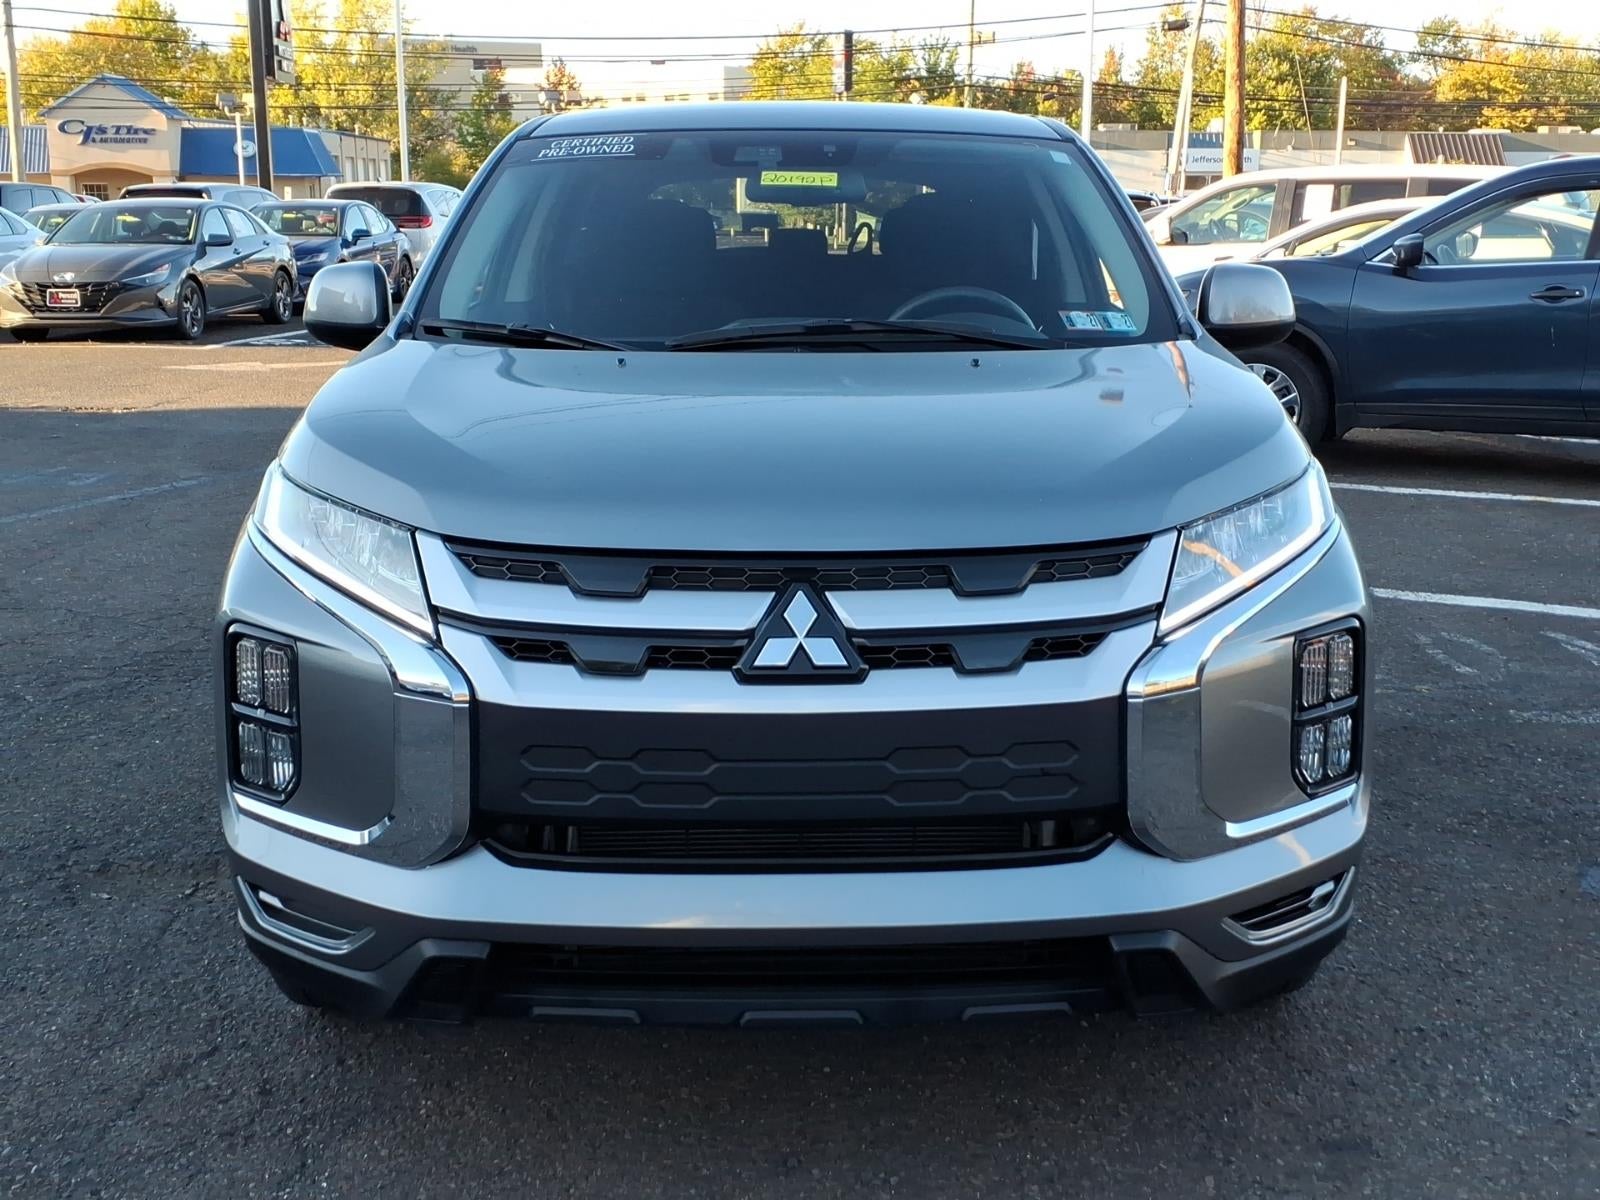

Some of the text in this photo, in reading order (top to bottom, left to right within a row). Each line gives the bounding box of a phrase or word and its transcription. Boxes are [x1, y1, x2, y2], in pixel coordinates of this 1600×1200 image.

[110, 124, 157, 136] Tire
[550, 136, 634, 149] CERTIFIED
[537, 144, 635, 158] PRE-OWNED
